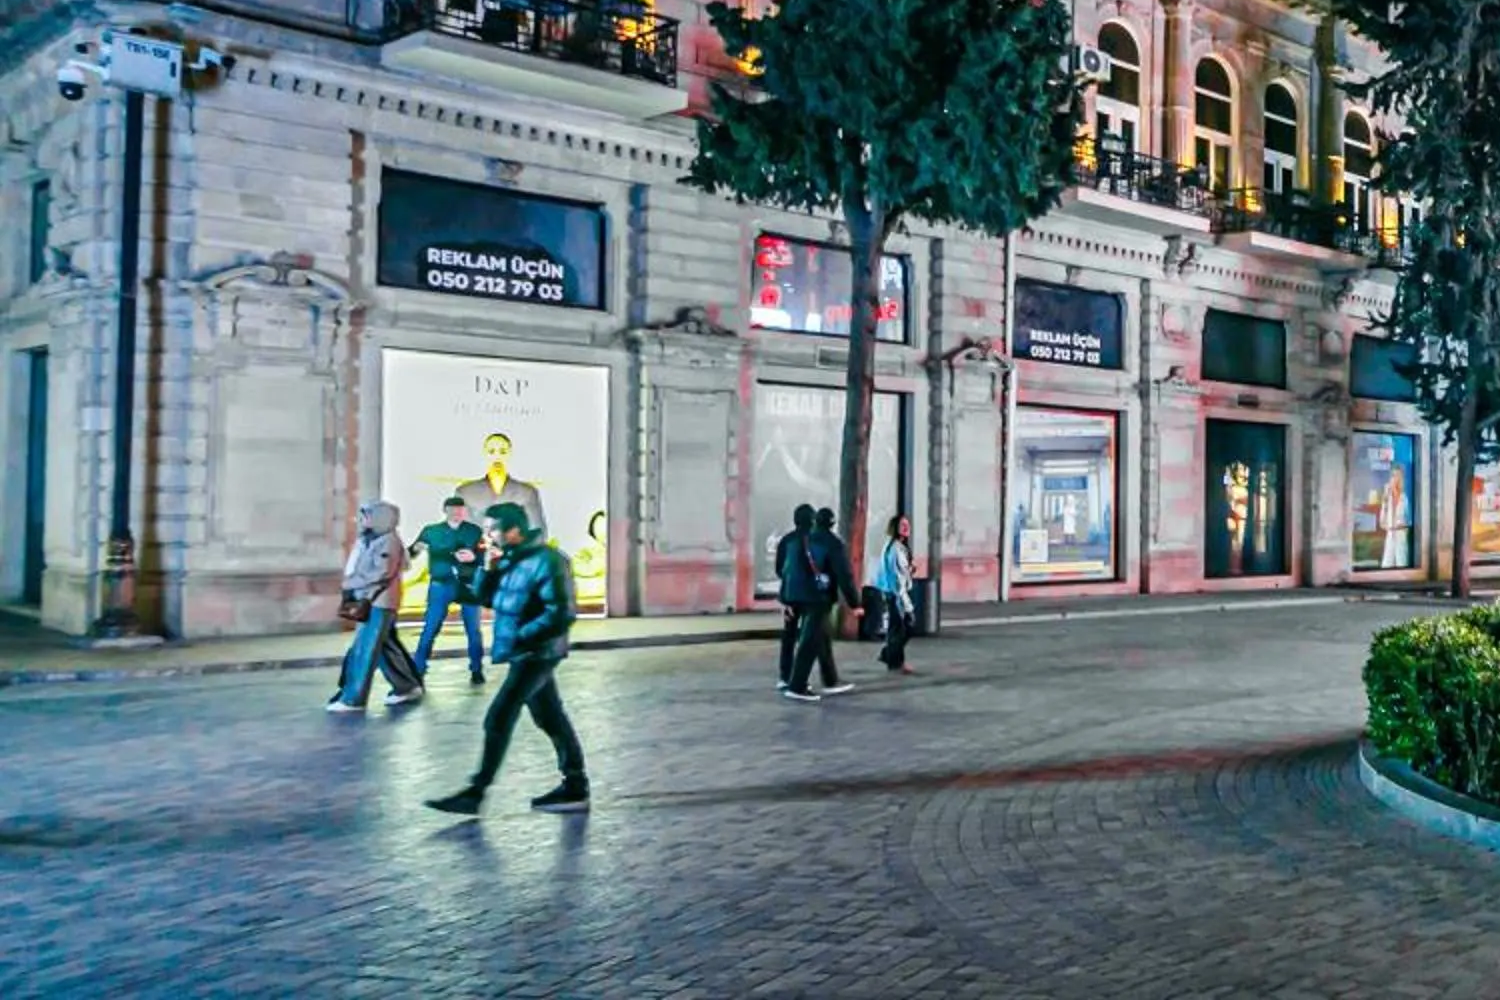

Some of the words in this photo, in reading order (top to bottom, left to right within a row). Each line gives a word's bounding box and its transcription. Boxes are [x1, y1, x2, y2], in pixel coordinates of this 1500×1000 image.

[427, 247, 506, 272] REKLAM
[511, 256, 564, 279] ÜÇÜN
[427, 270, 469, 289] 050
[473, 275, 506, 294] 212
[511, 280, 534, 297] 79
[538, 284, 563, 301] 03
[1030, 329, 1071, 345] REKLAM
[1030, 345, 1053, 359] 050
[1053, 347, 1071, 361] 212
